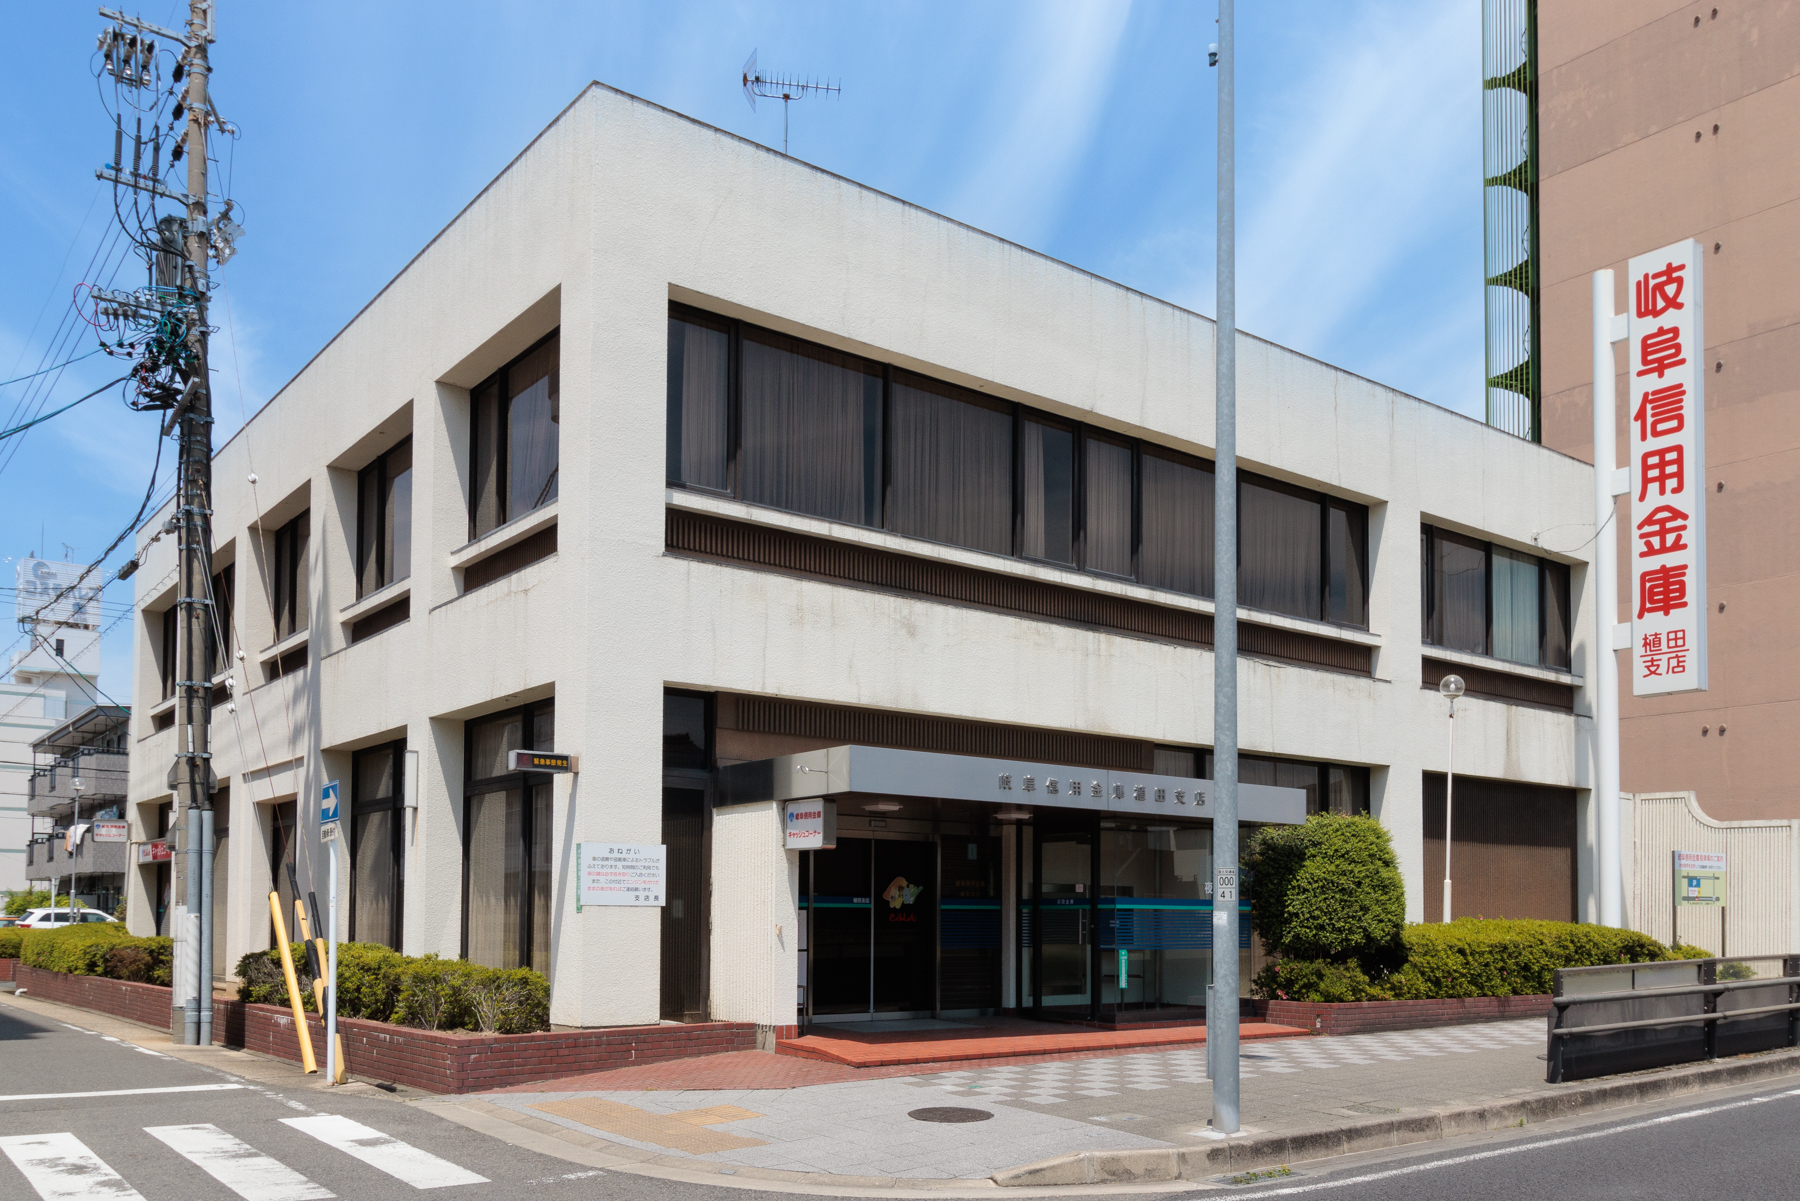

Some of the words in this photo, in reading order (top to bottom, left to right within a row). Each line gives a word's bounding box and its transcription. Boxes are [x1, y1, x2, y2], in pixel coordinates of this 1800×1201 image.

[1634, 263, 1689, 619] 岐阜信用金庫
[1642, 629, 1686, 653] 植田
[1643, 654, 1686, 678] 支店
[788, 829, 821, 839] キャッシュコーナー
[608, 847, 640, 855] おねがい
[1219, 876, 1234, 886] 000
